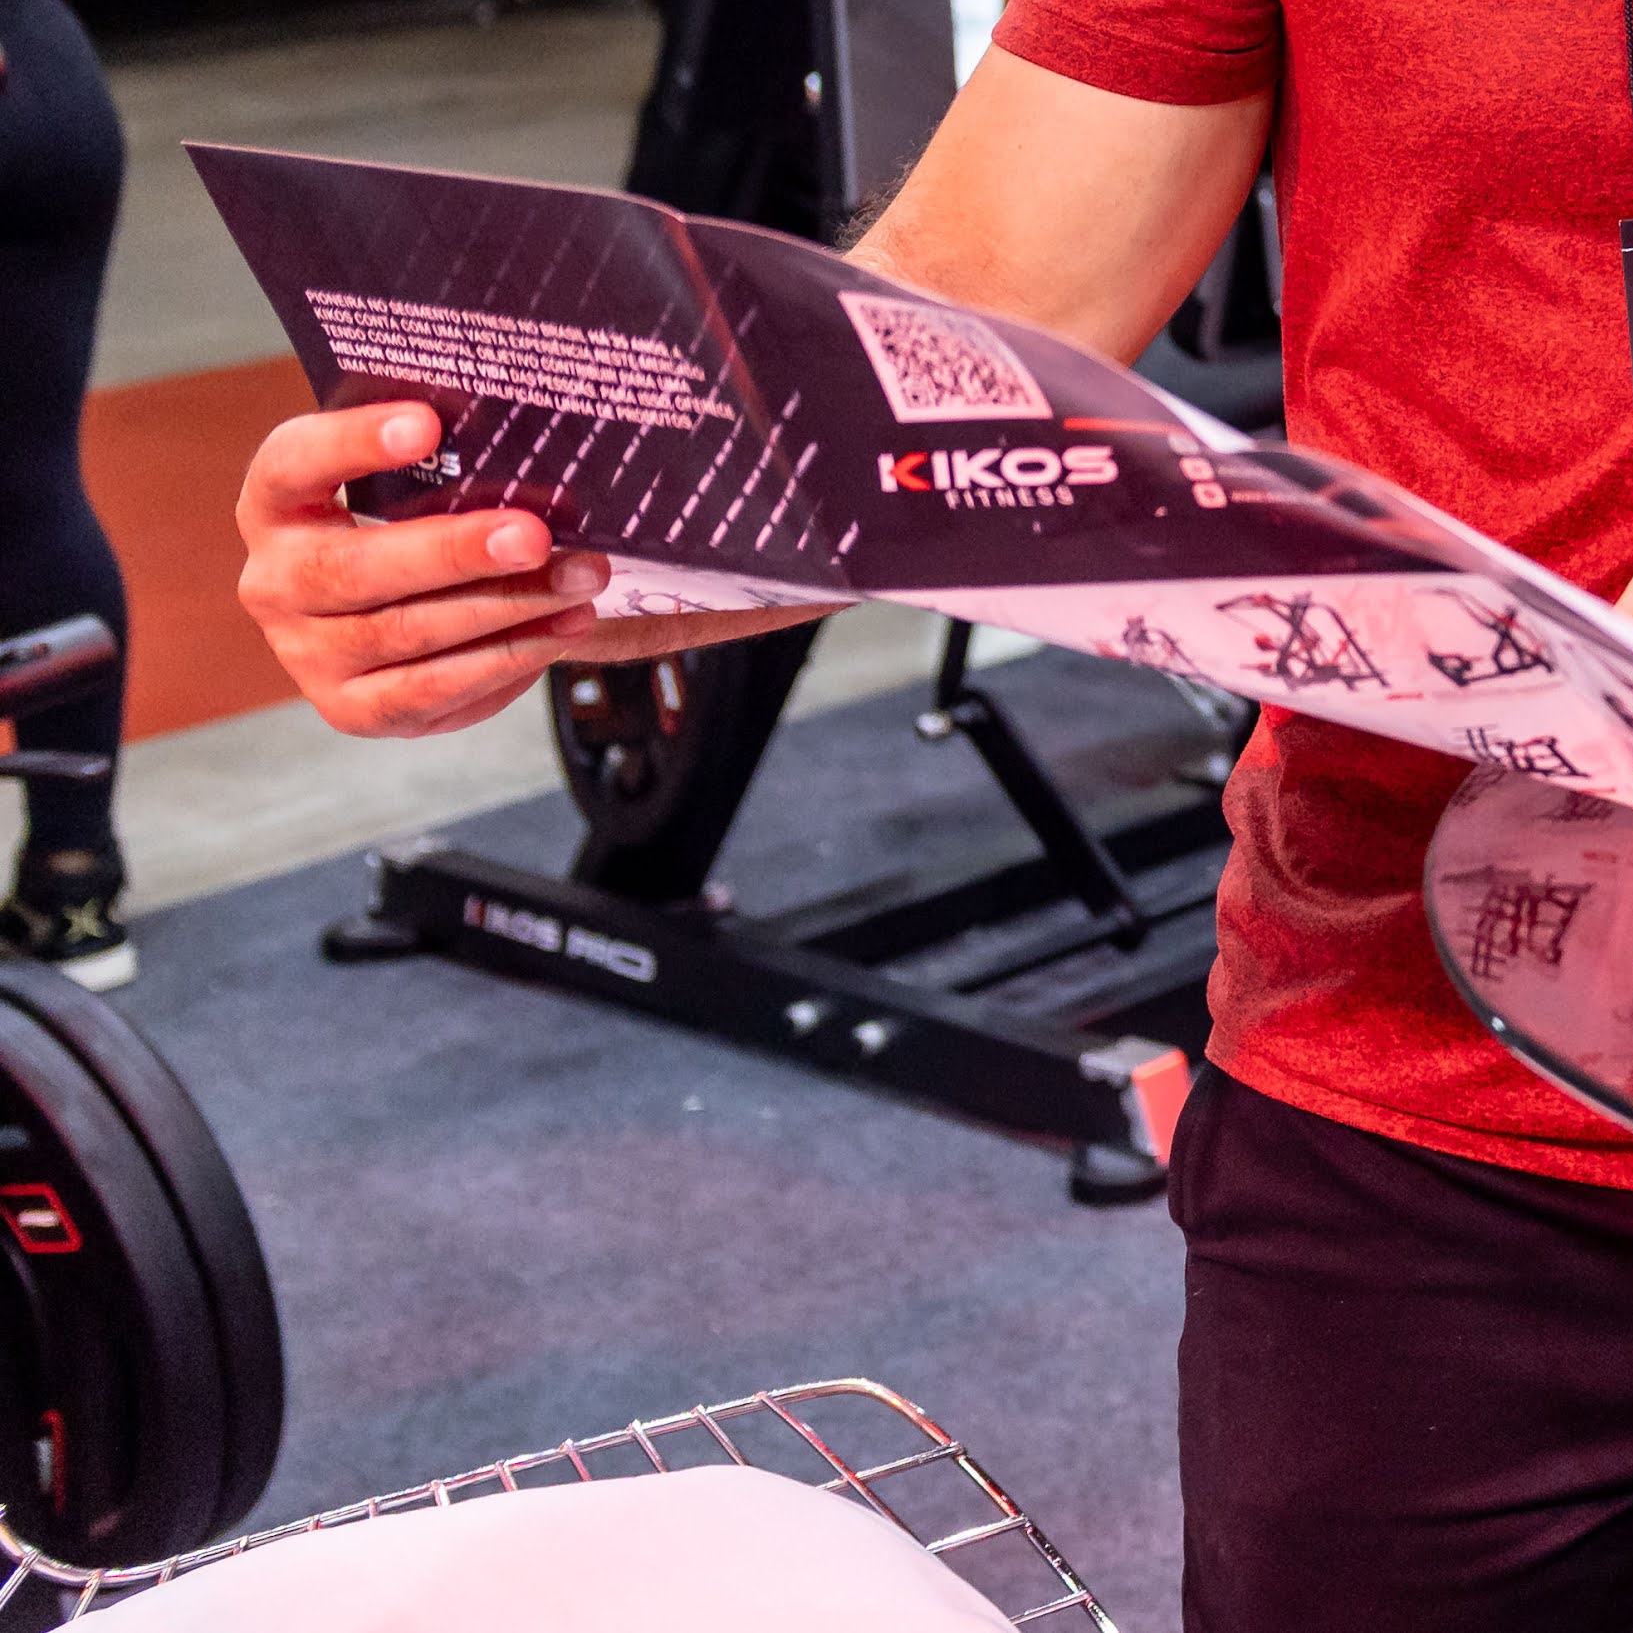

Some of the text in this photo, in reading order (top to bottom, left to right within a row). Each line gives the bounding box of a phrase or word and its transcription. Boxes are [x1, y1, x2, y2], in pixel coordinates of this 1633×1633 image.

[304, 287, 368, 311] PIONEIRA
[366, 296, 389, 314] NO
[312, 304, 354, 325] KIKOS
[353, 310, 401, 331] CONTA
[399, 318, 433, 336] COM
[431, 323, 465, 342] UMA
[463, 328, 509, 348] VASTA
[320, 322, 367, 343] TENDO
[366, 328, 409, 349] COMO
[407, 335, 476, 360] PRINCIPAL
[475, 344, 540, 370] OBJETIVO
[327, 340, 385, 361] MELHOR
[384, 347, 458, 374] QUALIDADE
[456, 357, 477, 377] DE
[475, 362, 510, 382] VIDA
[508, 368, 538, 388] DAS
[336, 356, 369, 374] UMA
[367, 360, 463, 390] DIVERSIFICADA
[461, 376, 473, 393] E
[472, 376, 555, 408] QUALIFICADA
[553, 394, 597, 417] LINHA
[877, 445, 1120, 493] KIKOS
[944, 484, 1075, 510] FITNESS
